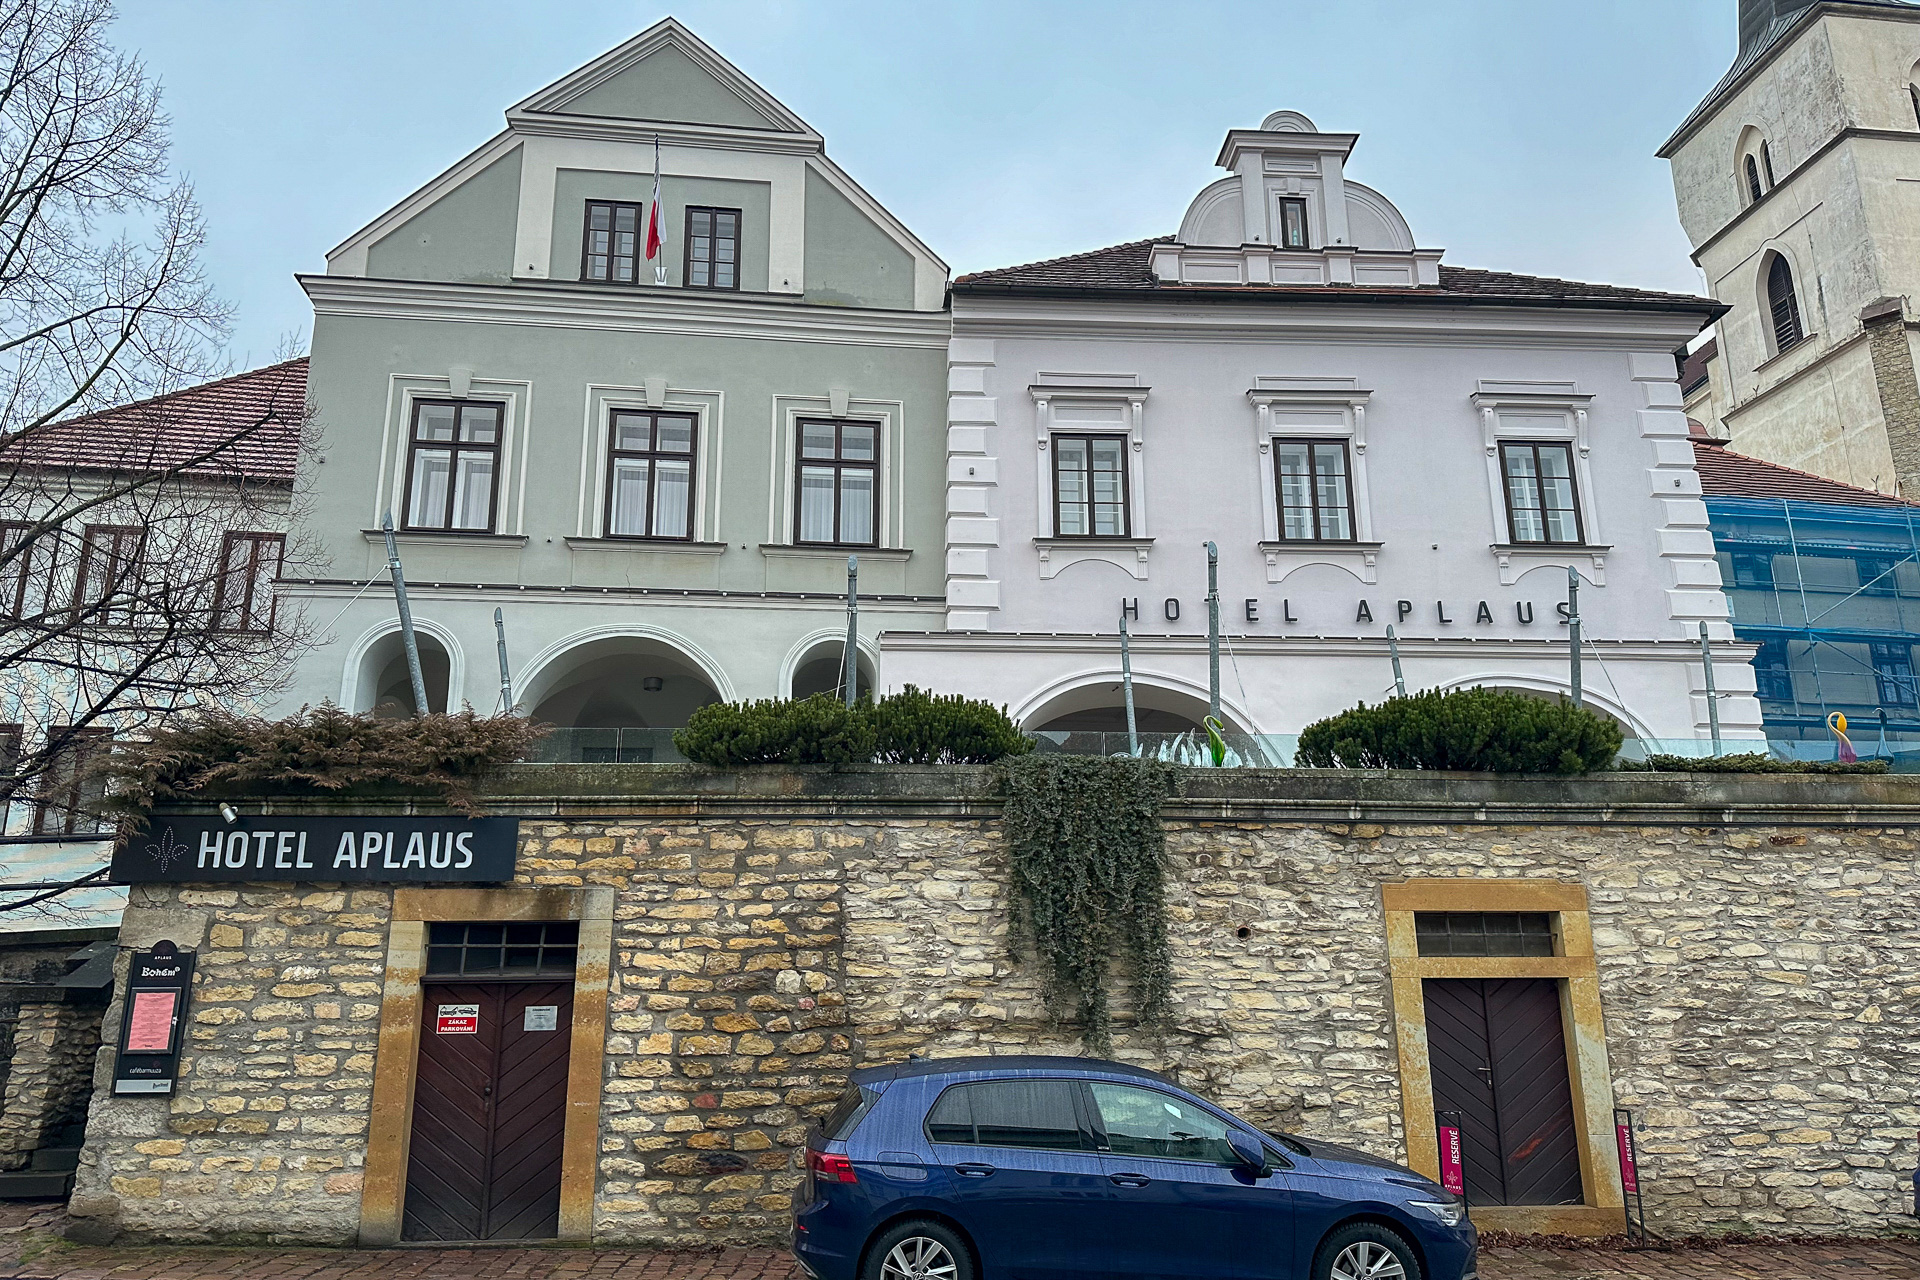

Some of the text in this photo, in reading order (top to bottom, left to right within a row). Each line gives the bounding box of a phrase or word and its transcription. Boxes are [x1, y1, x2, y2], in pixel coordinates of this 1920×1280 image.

[1122, 598, 1570, 625] HOEL APLAUS
[197, 831, 474, 869] HOTEL APLAUS
[1449, 1130, 1459, 1164] RESERVÉ
